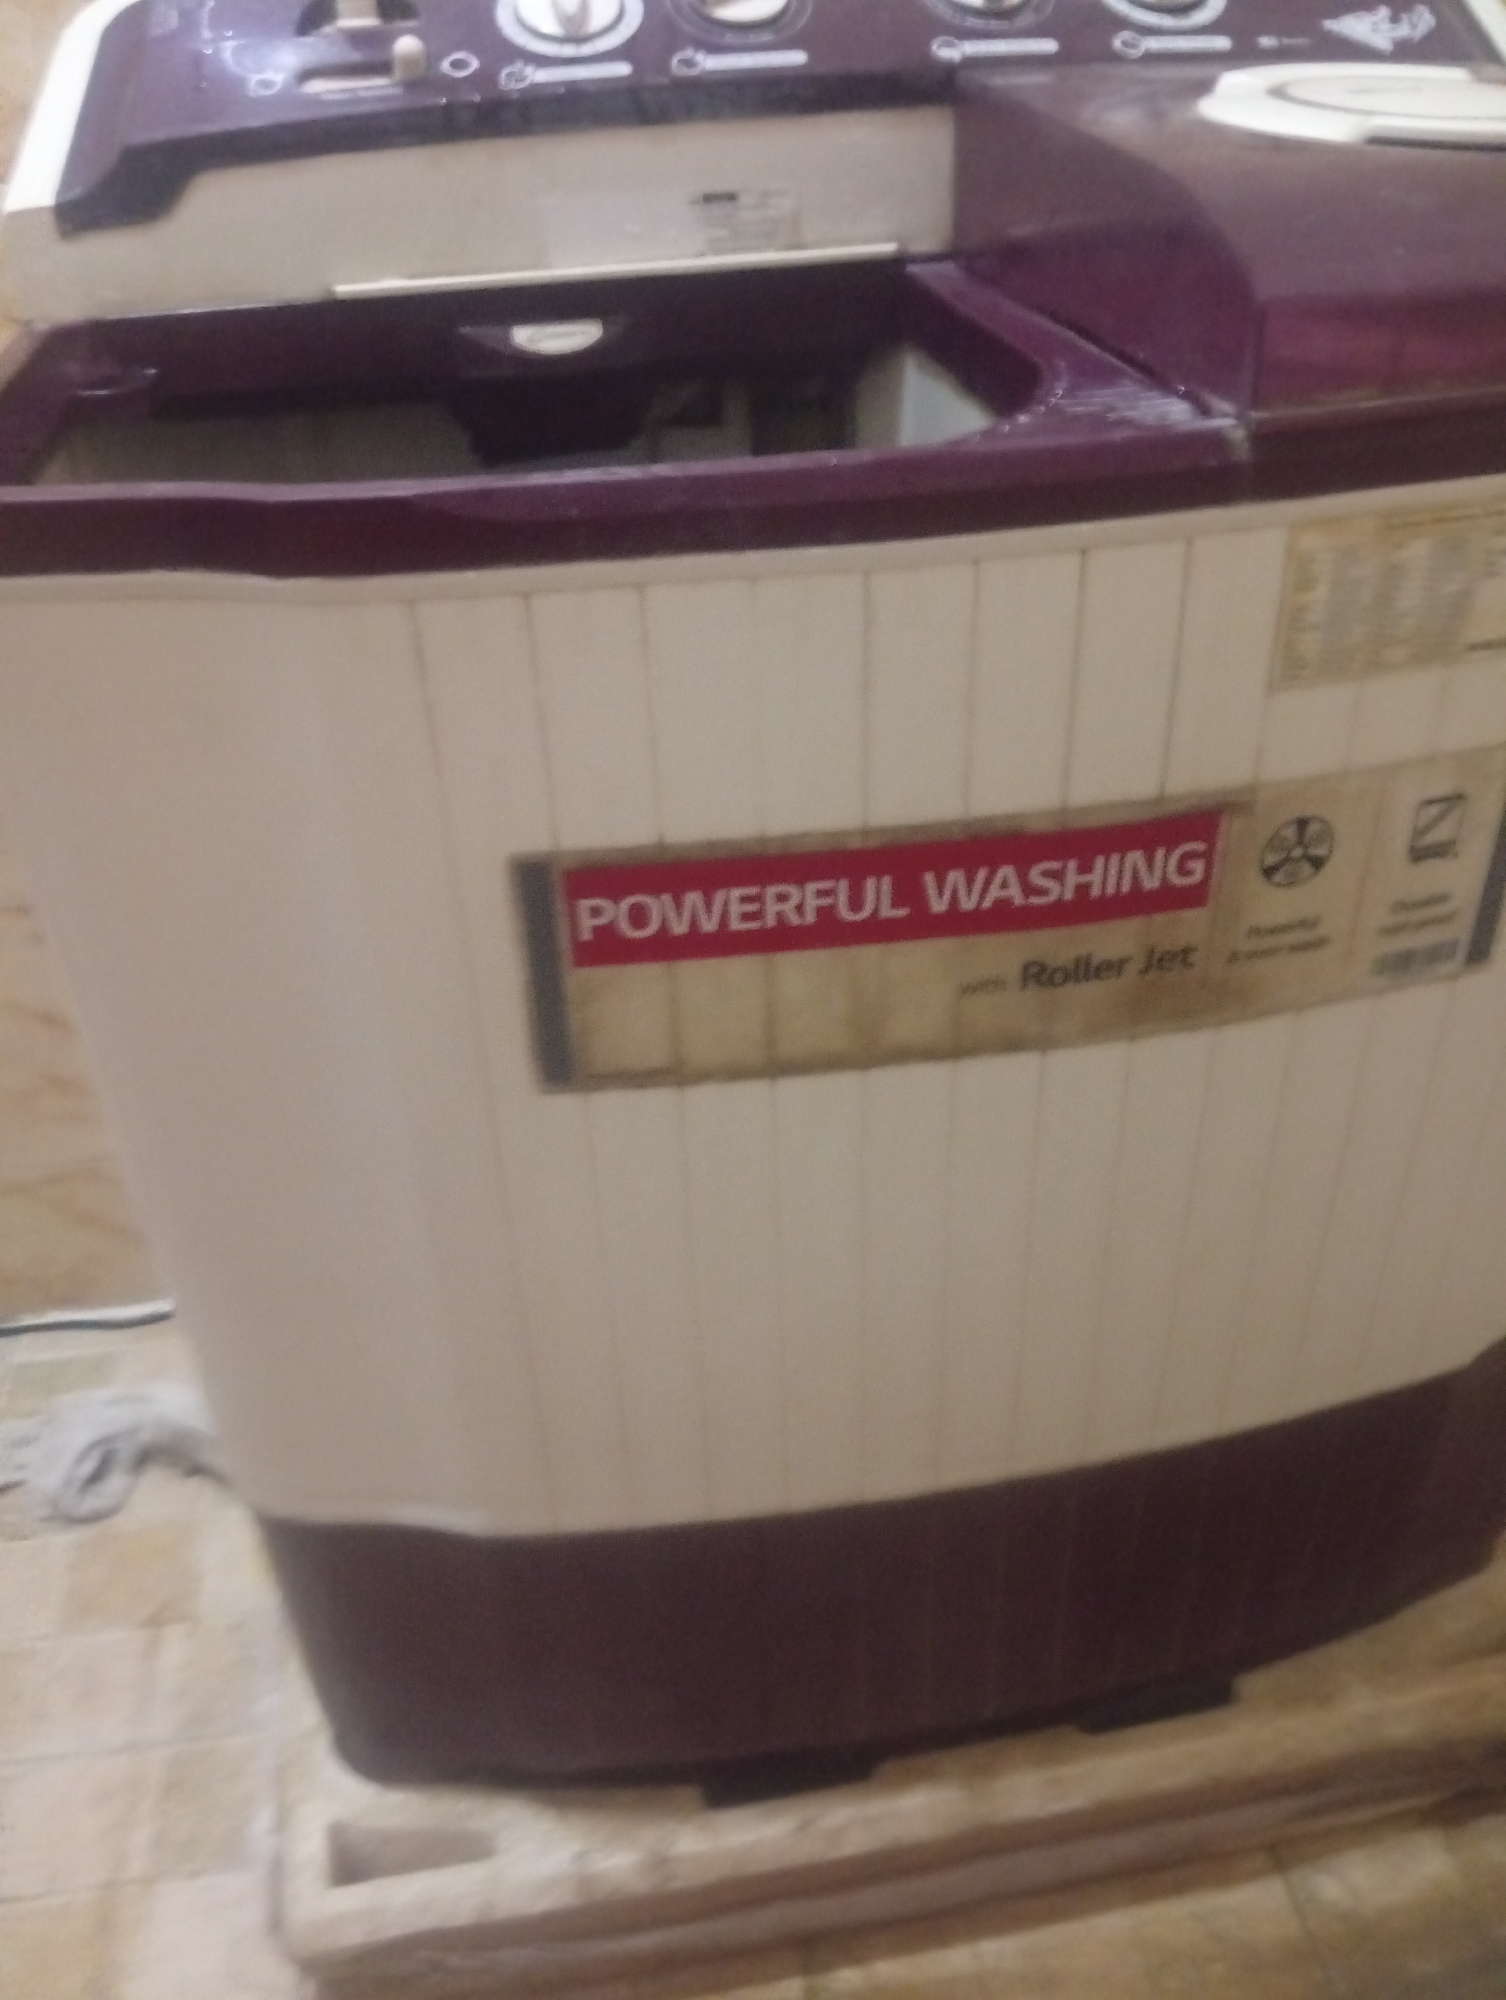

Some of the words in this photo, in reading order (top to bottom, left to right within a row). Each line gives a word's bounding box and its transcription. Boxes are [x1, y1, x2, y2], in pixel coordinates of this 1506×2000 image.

[577, 874, 911, 942] POWERFUL
[923, 840, 1208, 914] WASHING
[1019, 953, 1133, 991] Roller
[1137, 943, 1197, 977] Jet
